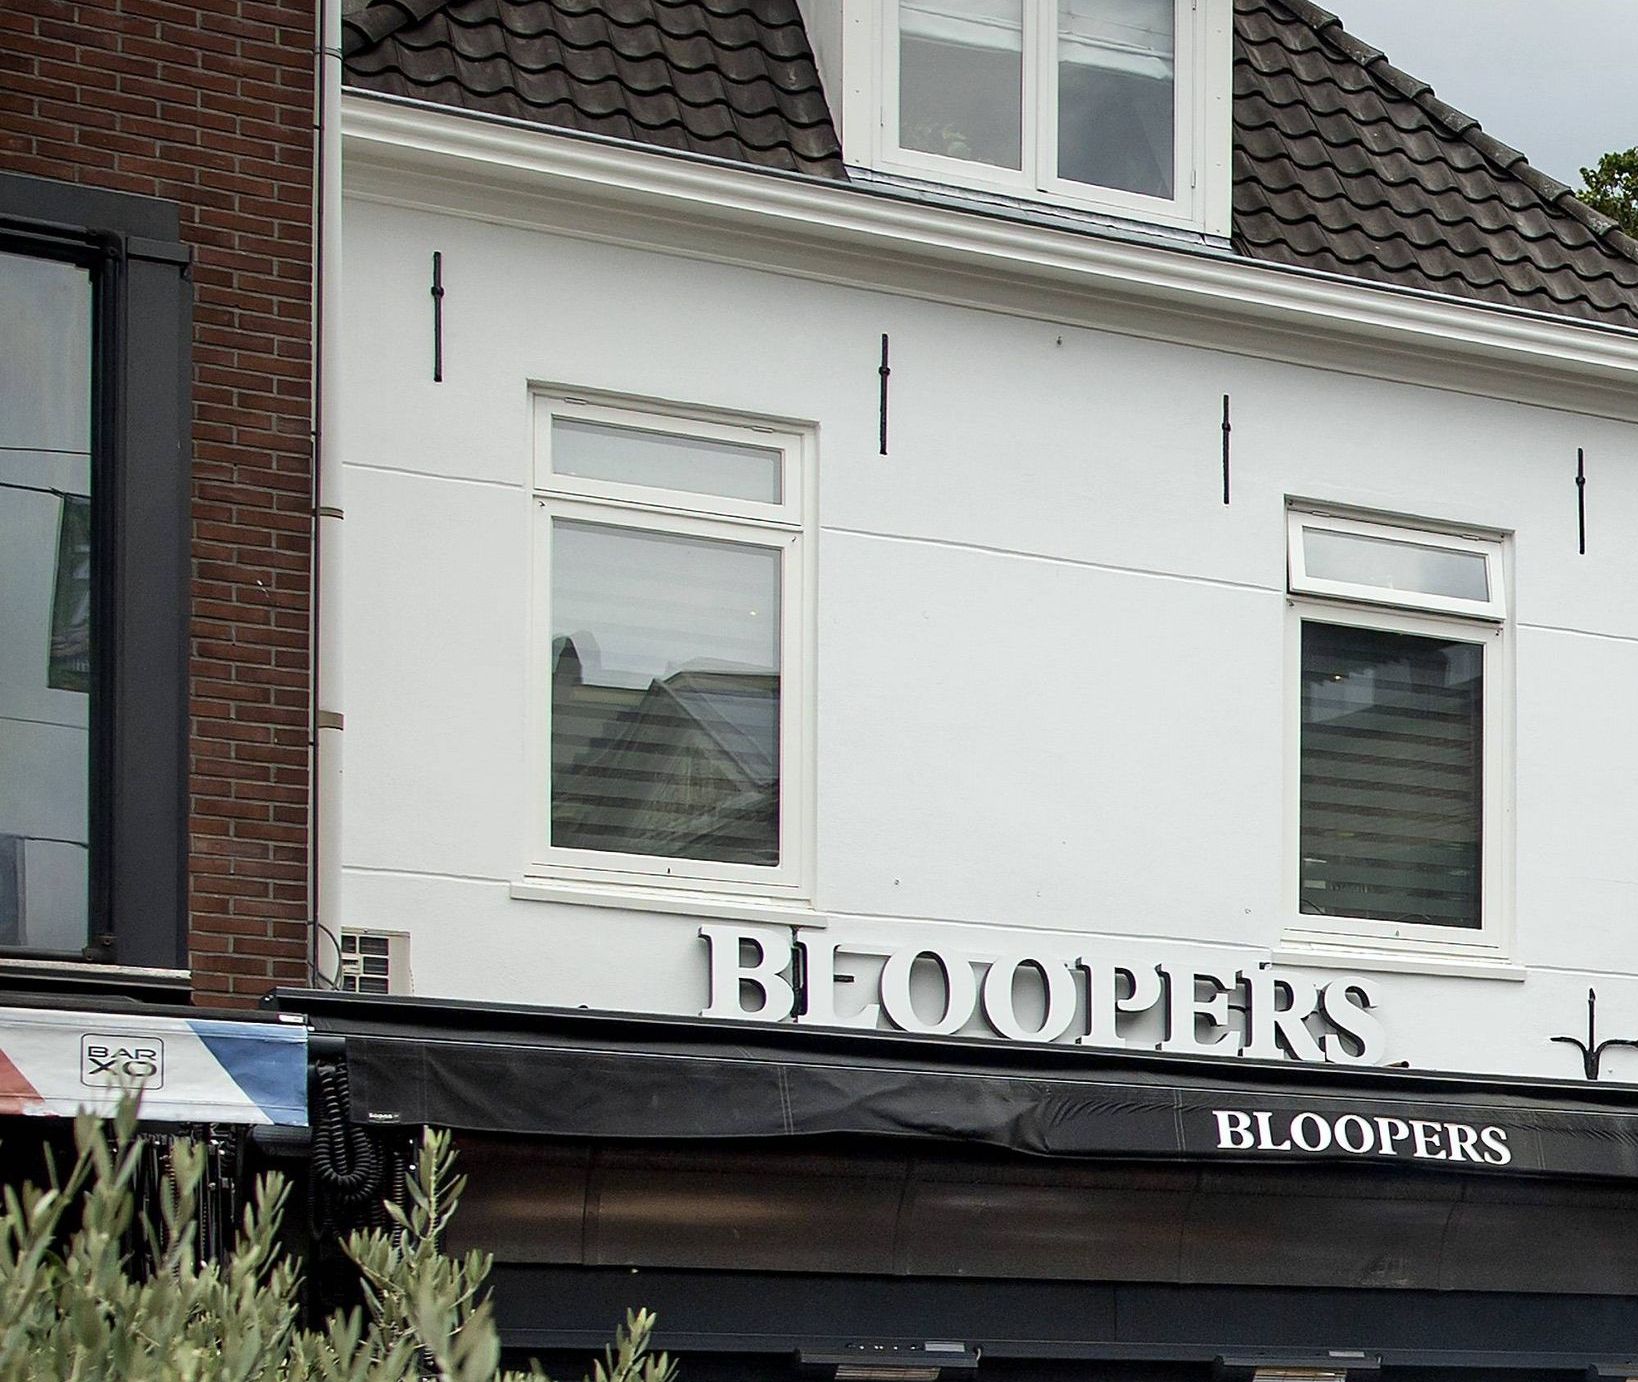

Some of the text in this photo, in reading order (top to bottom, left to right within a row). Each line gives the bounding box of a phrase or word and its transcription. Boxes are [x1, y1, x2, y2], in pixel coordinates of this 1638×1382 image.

[698, 924, 1388, 1067] BLOOPERS
[88, 1046, 156, 1060] BAR
[88, 1058, 157, 1077] XO
[1213, 1110, 1513, 1167] BLOOPERS
